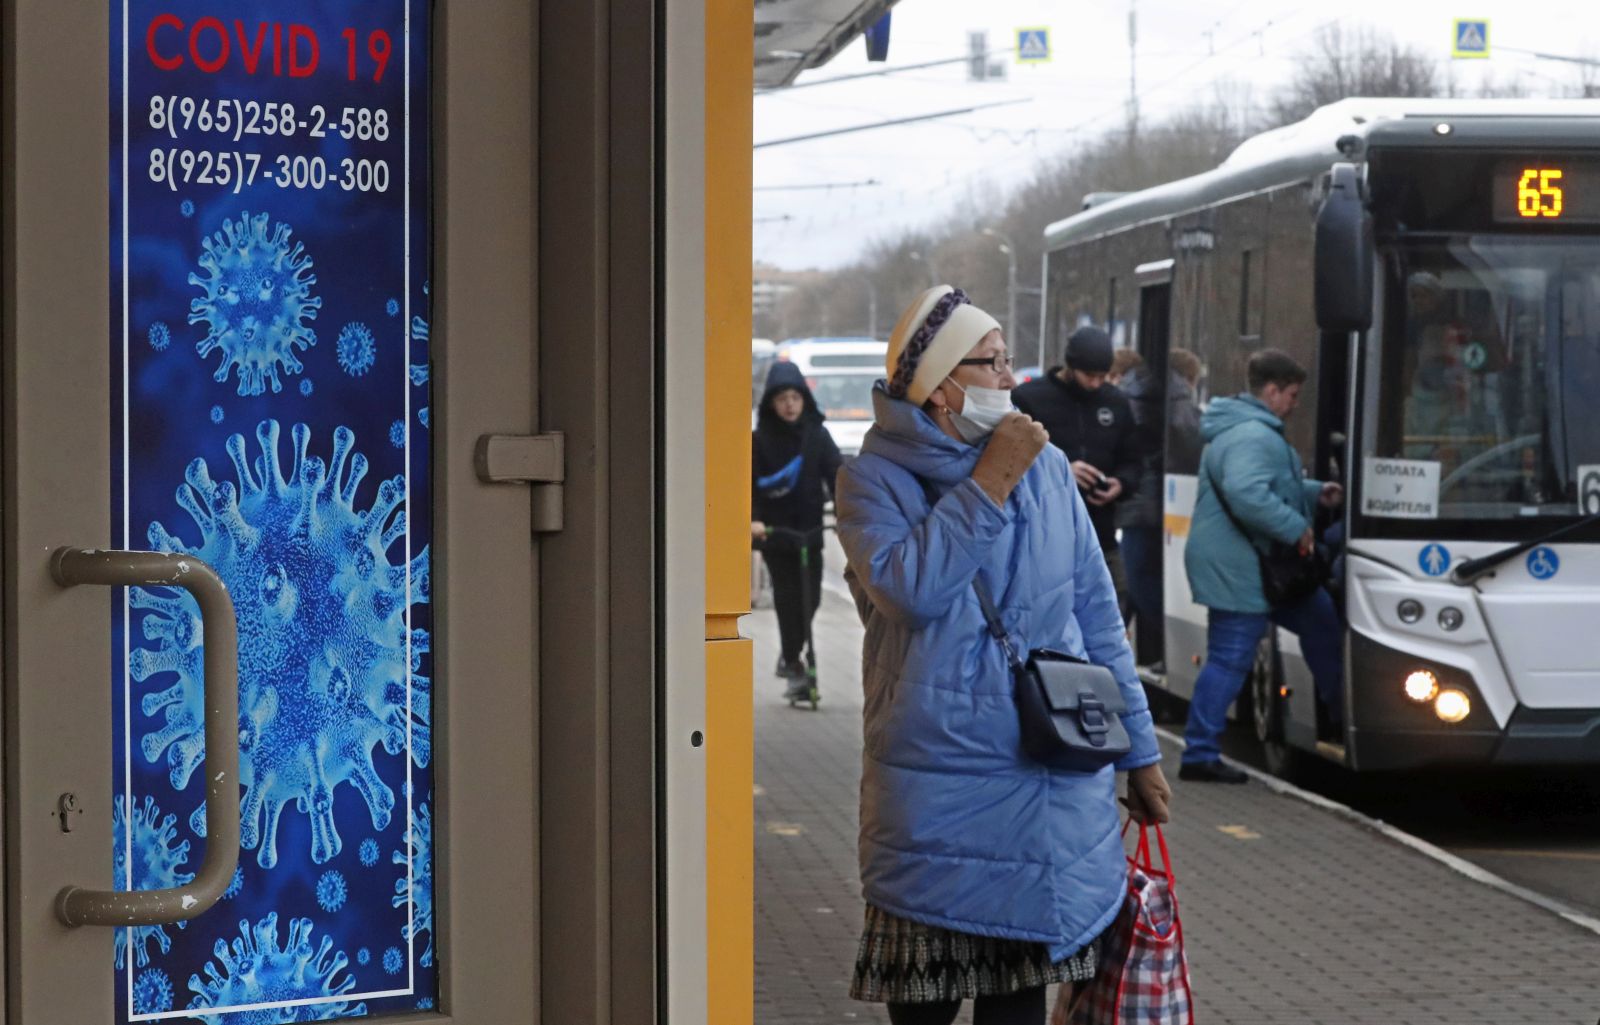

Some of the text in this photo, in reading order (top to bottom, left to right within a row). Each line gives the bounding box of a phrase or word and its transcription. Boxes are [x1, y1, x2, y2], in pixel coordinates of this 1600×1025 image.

[146, 13, 392, 82] COVID 19
[149, 95, 389, 141] 8(965)258-2-588
[149, 148, 390, 193] 8(925)7-300-300
[1518, 169, 1562, 217] 65
[1375, 463, 1426, 478] ОПЛАТА
[1366, 499, 1432, 514] ВОДИТЕЛЯ
